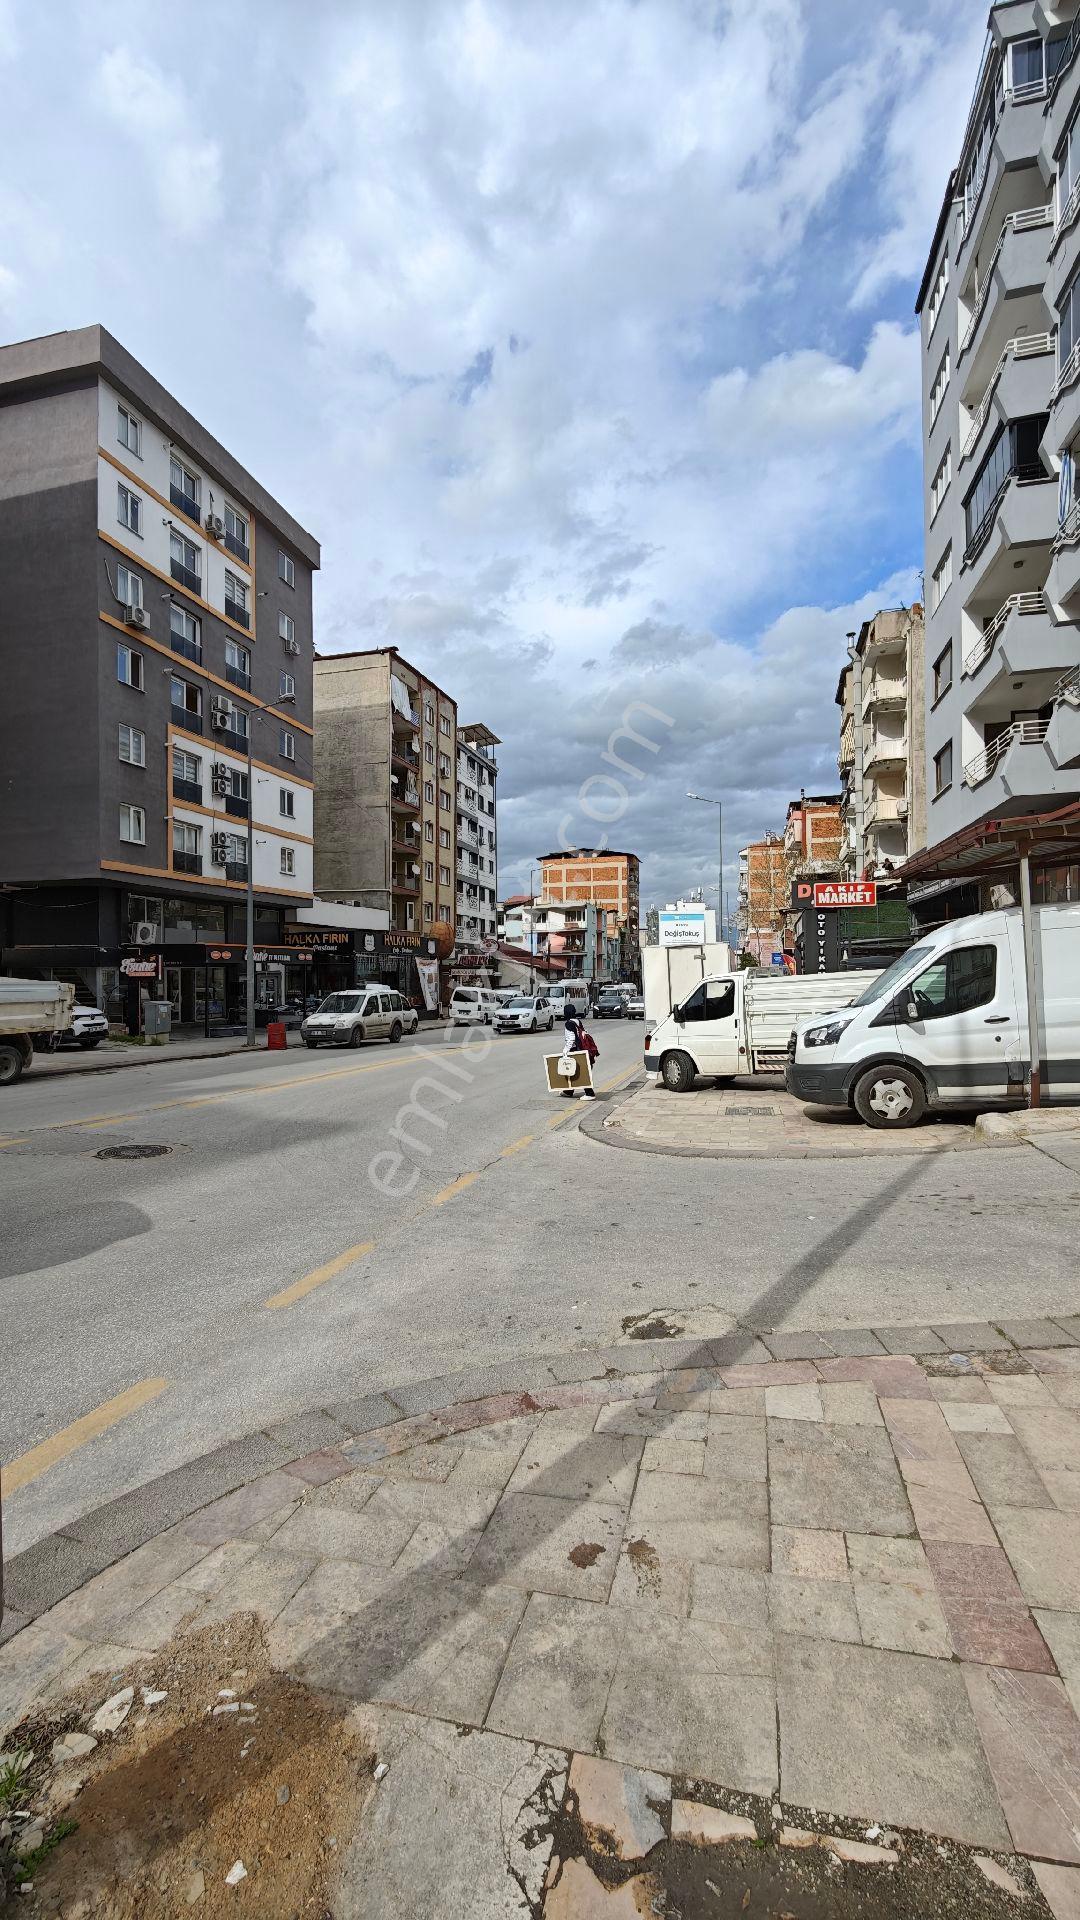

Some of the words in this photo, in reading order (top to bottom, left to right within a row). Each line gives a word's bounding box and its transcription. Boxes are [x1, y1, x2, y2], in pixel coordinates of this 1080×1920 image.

[818, 892, 872, 904] MARKET
[817, 913, 826, 936] OTO
[284, 934, 320, 945] HALKA
[322, 933, 349, 944] FIRIN
[384, 934, 406, 947] HALKA
